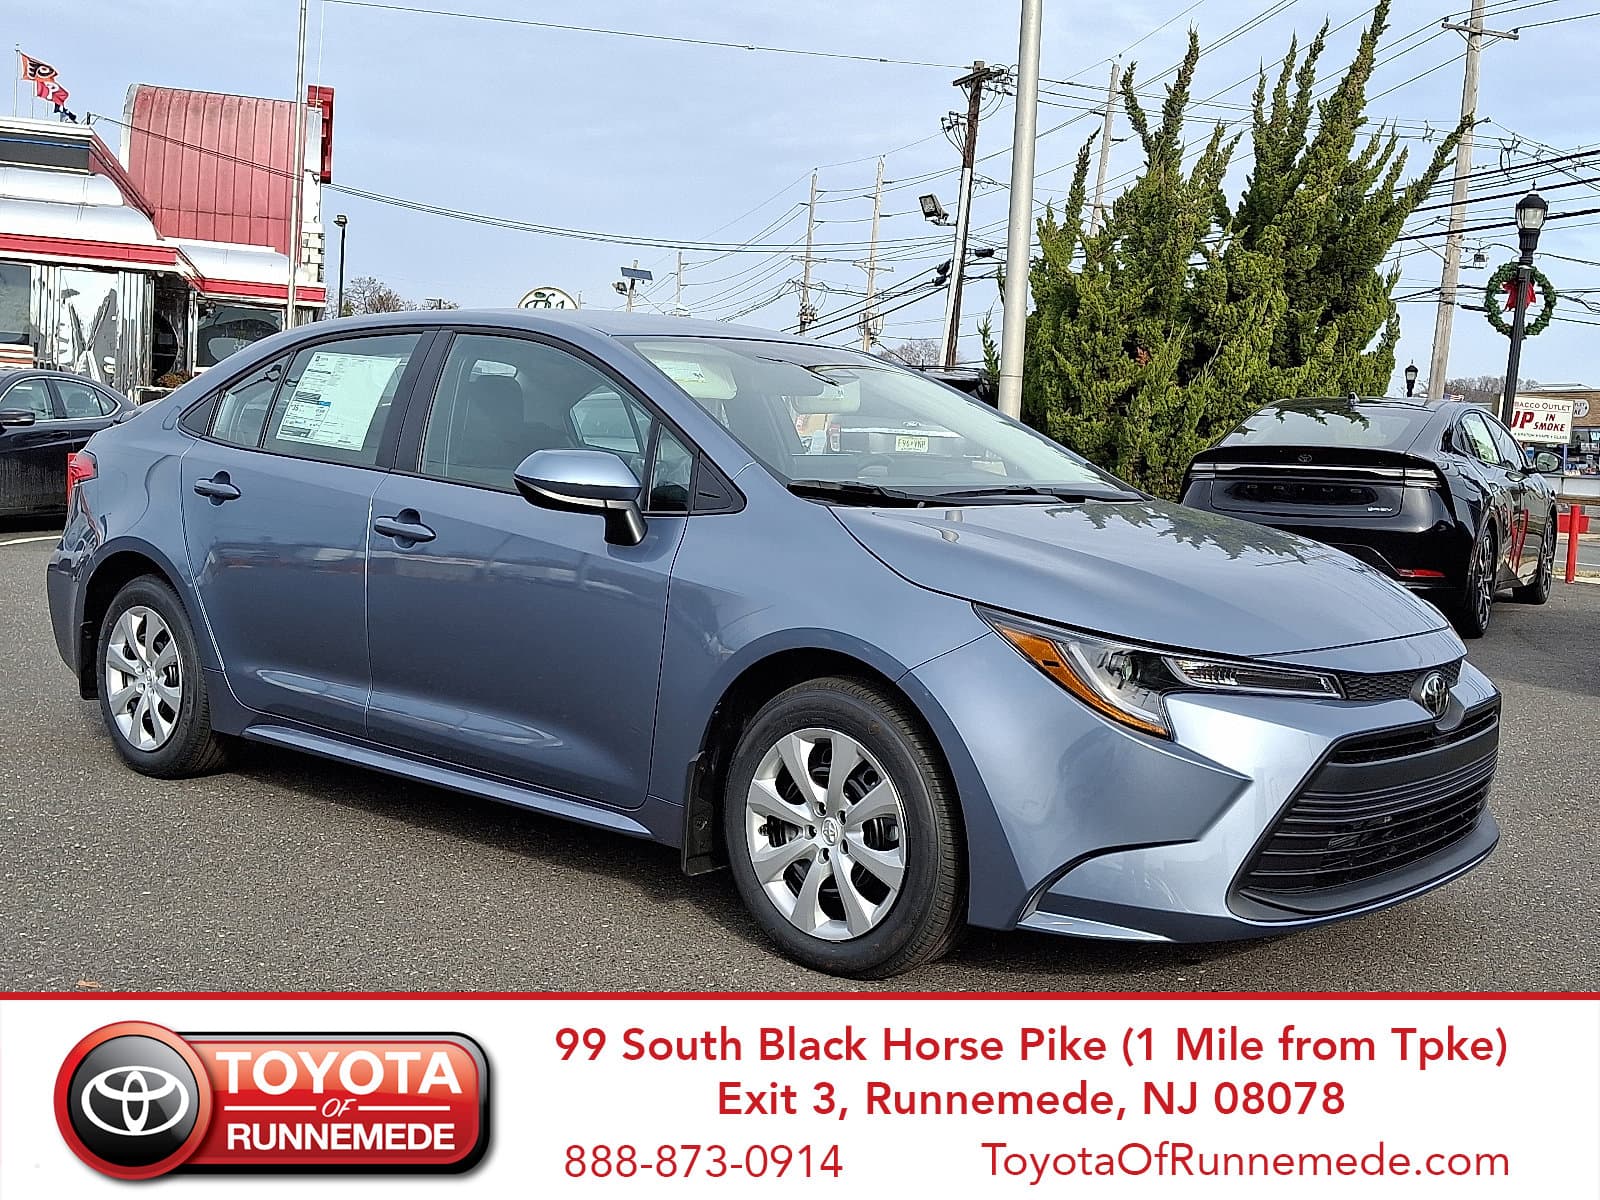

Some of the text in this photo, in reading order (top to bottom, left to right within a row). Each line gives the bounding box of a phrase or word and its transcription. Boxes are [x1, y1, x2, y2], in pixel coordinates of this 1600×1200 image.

[1542, 402, 1571, 412] OUTLET
[1545, 413, 1556, 422] IN
[1533, 421, 1566, 432] SMOKE
